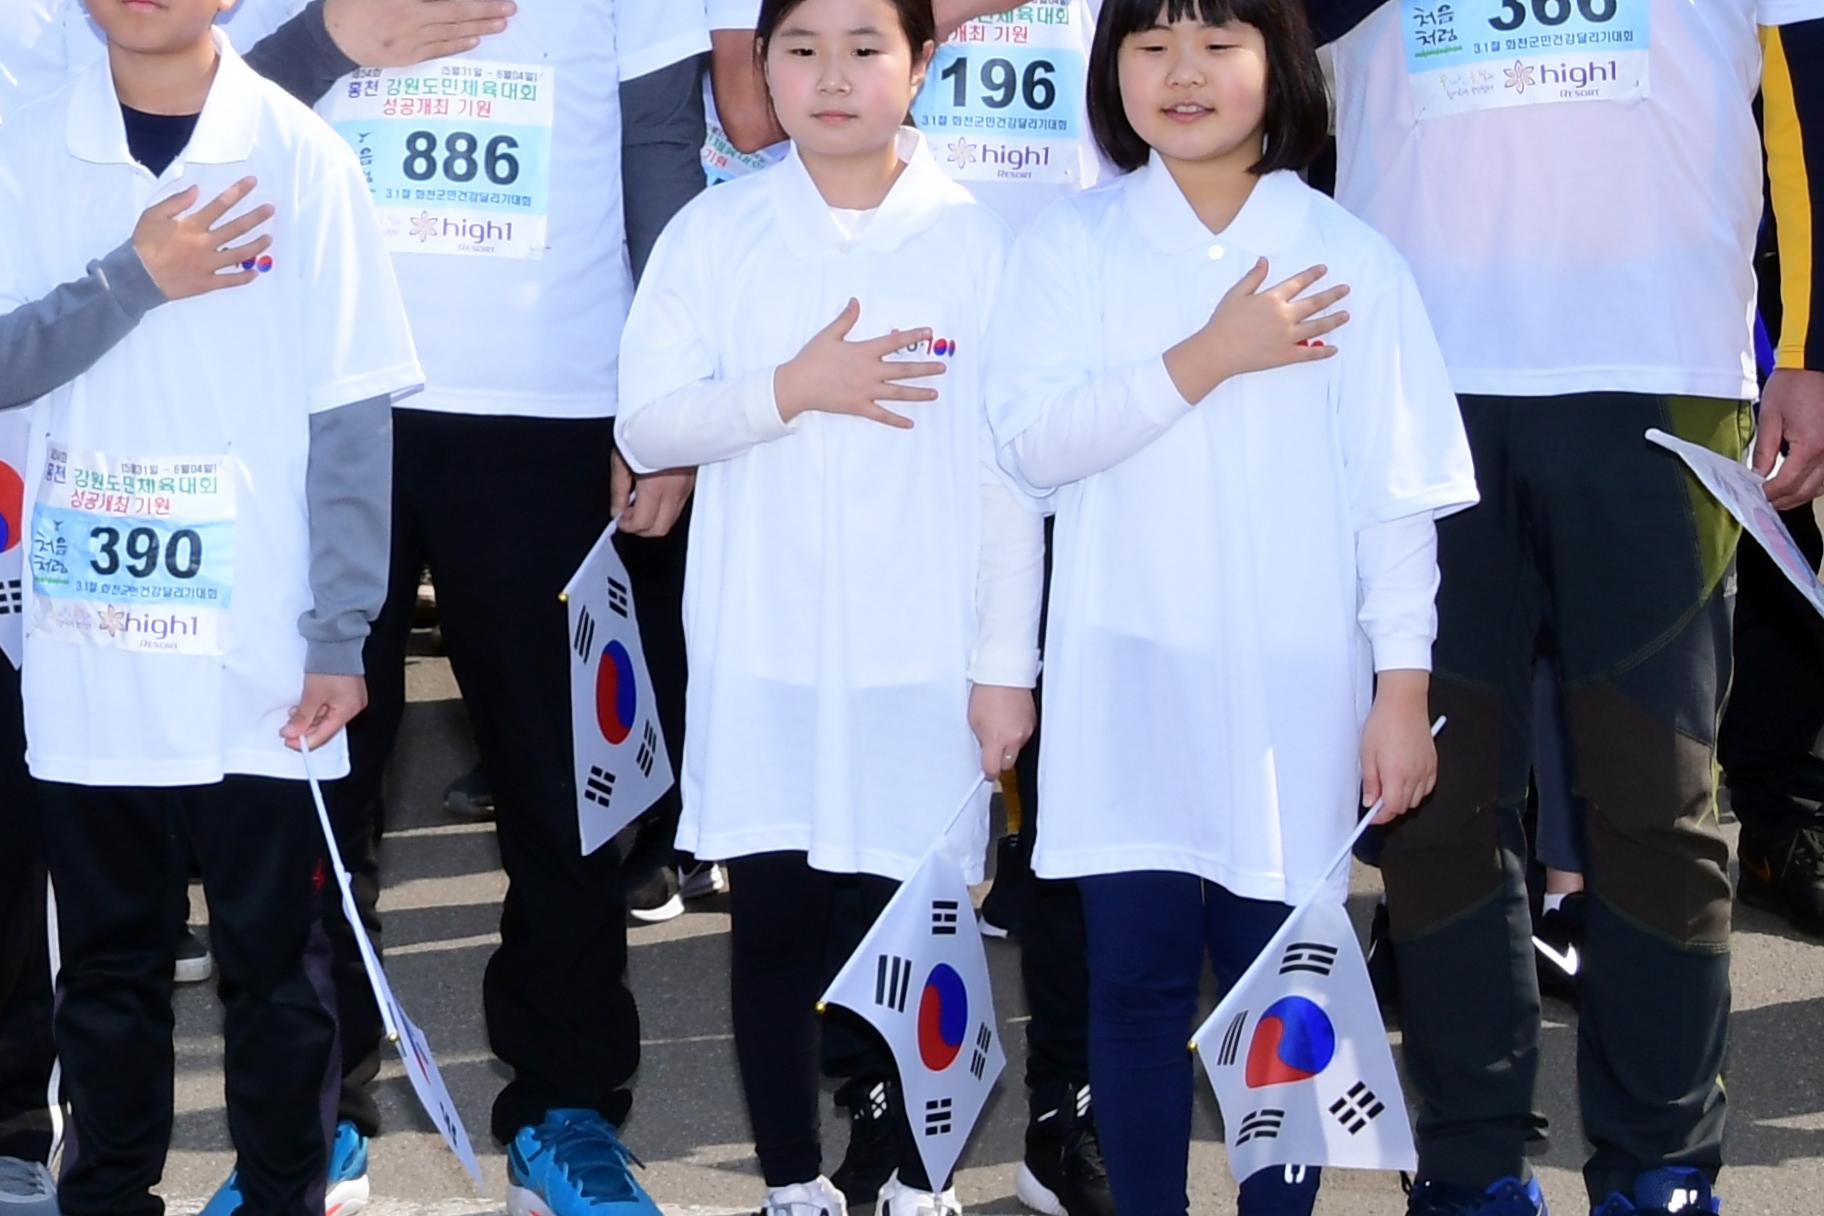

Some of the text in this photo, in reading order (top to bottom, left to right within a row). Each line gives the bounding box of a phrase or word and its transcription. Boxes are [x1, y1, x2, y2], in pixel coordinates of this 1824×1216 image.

[994, 25, 1028, 43] 기원
[1505, 30, 1634, 51] 화천군민건강달리기대회
[941, 57, 1056, 110] 196
[1540, 60, 1616, 88] high1
[348, 77, 537, 101] 홍천 강원도민체육대회
[383, 97, 492, 118] 성공개최 기원
[952, 115, 1068, 131] 화천군민건강달리기대회
[402, 130, 520, 186] 886
[982, 144, 1049, 170] high1
[442, 217, 513, 244] high1
[74, 469, 218, 495] 강원도민체육대회
[70, 490, 171, 516] 성공개최 기원
[89, 526, 203, 579] 390
[124, 611, 198, 640] high1
